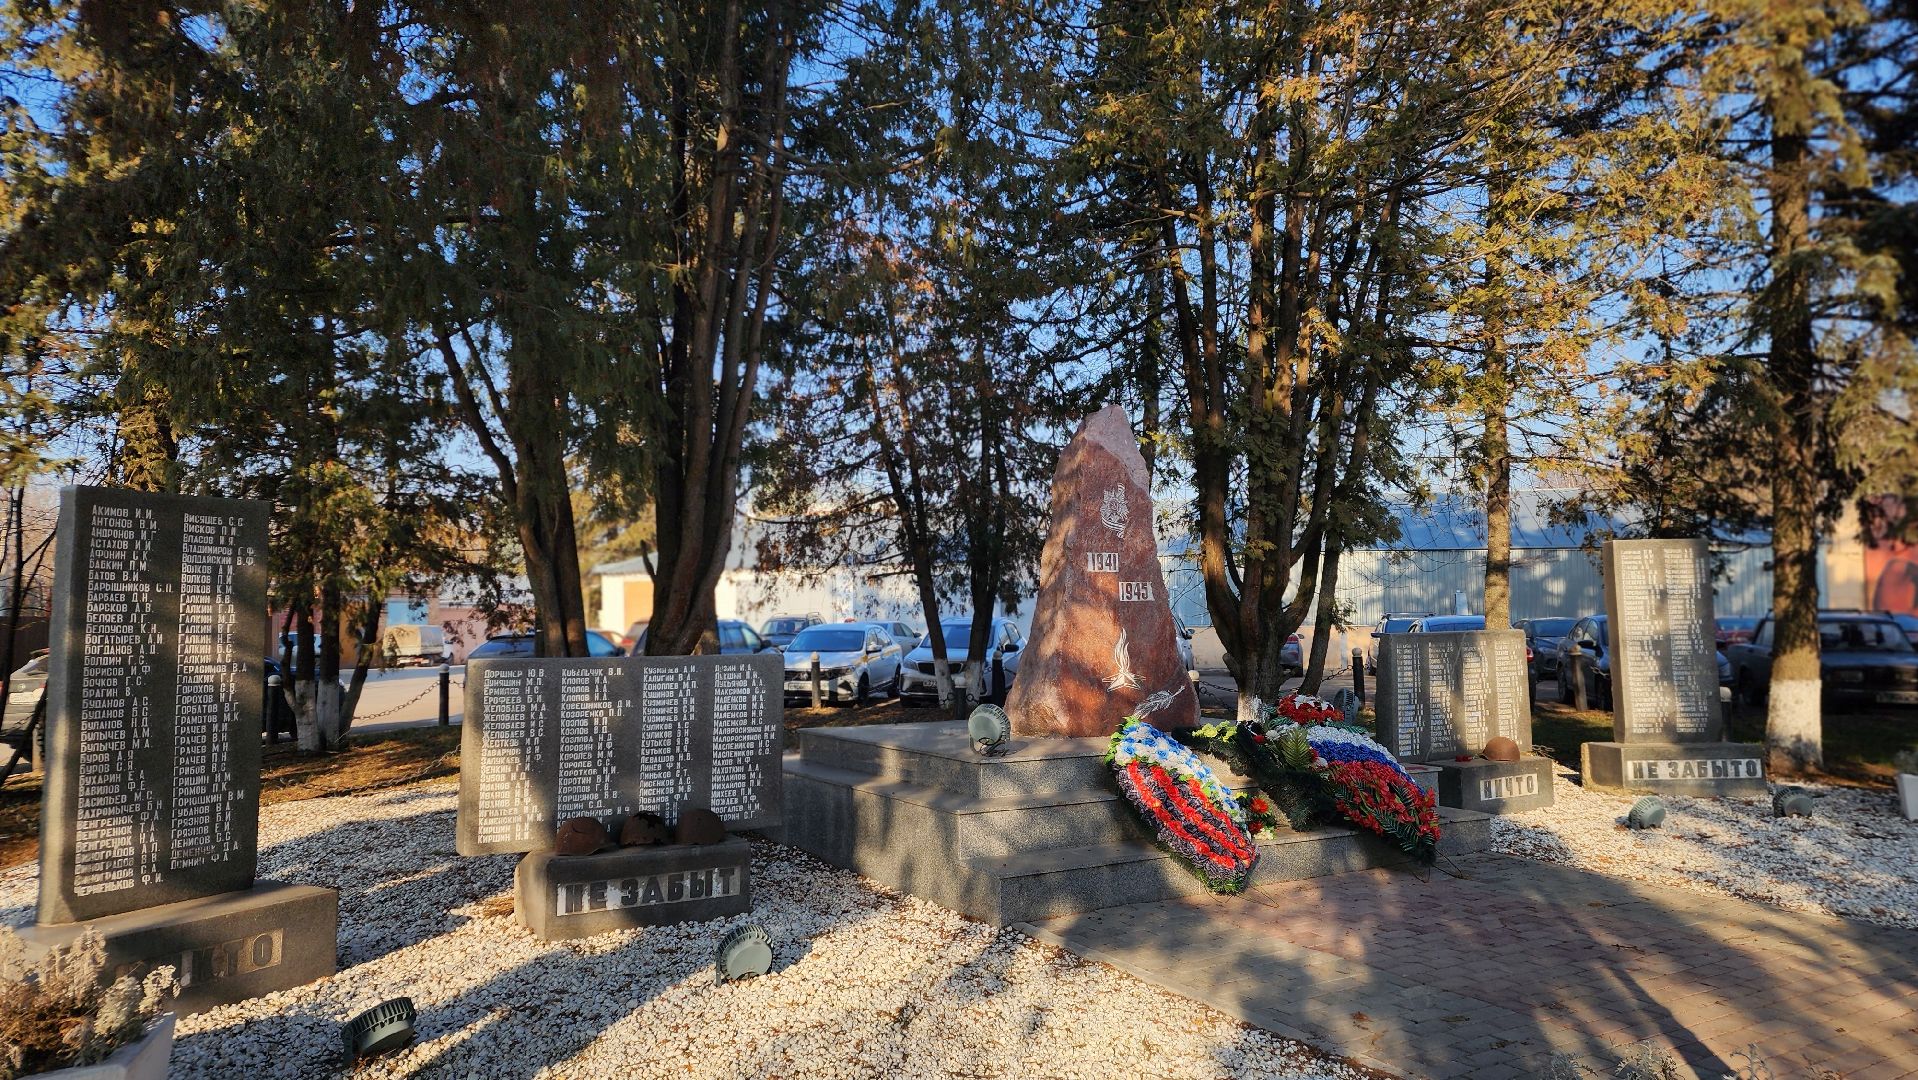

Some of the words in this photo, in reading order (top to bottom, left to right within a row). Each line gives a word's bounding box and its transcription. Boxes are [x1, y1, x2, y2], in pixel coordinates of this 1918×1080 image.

[92, 505, 129, 517] АКИМОВ
[91, 516, 132, 528] АНТОНОВ
[91, 527, 134, 539] АНДРОНОВ
[184, 523, 215, 534] ВИСКОВ
[91, 538, 128, 550] АСТАХОВ
[183, 534, 213, 544] ВЛАСОВ
[90, 548, 125, 560] АФОНИН
[182, 543, 232, 555] ВЛАДИМИРОВ
[89, 559, 122, 570] БАБКИН
[1091, 553, 1117, 571] 1941
[182, 563, 211, 574] ВОЛКОВ
[88, 570, 115, 580] БАТОВ
[122, 572, 142, 582] В.И.
[181, 574, 211, 583] ВОЛКОВ
[88, 580, 150, 592] БАРЫШНИКОВ
[181, 584, 210, 594] ВОЛКОВ
[88, 591, 125, 602] БАРБАЕВ
[1120, 582, 1149, 601] 1945
[180, 594, 210, 603] ГАЛКИН
[87, 602, 128, 612] БАРСКОВ
[180, 603, 212, 613] ГАЛКИН
[87, 613, 123, 623] БЕЛЯЕВ
[179, 613, 212, 624] ГАЛКИН
[86, 623, 133, 633] БЕЛОУСОВ
[179, 624, 212, 633] ГАЛКИН
[85, 634, 140, 644] БОГАТЫРЕВ
[178, 634, 211, 644] ГАЛКИН
[85, 645, 132, 655] БОГДАНОВ
[178, 645, 211, 654] ГАЛКИН
[84, 655, 121, 666] БОЛДИН
[178, 654, 211, 664] ГАЛКИН
[83, 666, 124, 676] БОРИСОВ
[177, 664, 226, 674] ГЕРАСИМОВ
[83, 676, 117, 687] БОЧКОВ
[177, 674, 214, 684] ГЛАДКИХ
[82, 688, 117, 698] БРАГИН
[176, 684, 213, 694] ГОРОХОВ
[484, 687, 519, 695] ЕРМИЛОВ
[82, 699, 124, 709] БУДАНОВ
[176, 695, 213, 705] ГОРОХОВ
[484, 696, 521, 704] ЕРОФЕЕВ
[175, 704, 218, 715] ГОРБАТОВ
[484, 704, 525, 712] ЖЕЛОБАЕВ
[82, 709, 124, 720] БУДАНОВ
[484, 713, 525, 721] ЖЕЛОБАЕВ
[175, 715, 217, 725] ГРАМОТОВ
[561, 719, 588, 727] КОЗЛОВ
[175, 725, 206, 735] ГРАЧЕВ
[483, 722, 525, 730] ЖЕЛОБАЕВ
[81, 730, 125, 742] БУЛЫЧЕВ
[483, 730, 524, 738] ЖЕЛОБАЕВ
[642, 732, 672, 740] КУЛИКОВ
[174, 735, 206, 745] ГРАЧЕВ
[560, 736, 593, 744] КОЗЛОВА
[81, 740, 125, 752] БУЛЫЧЕВ
[174, 746, 206, 756] ГРАЧЕВ
[560, 744, 592, 752] КОРОВИН
[80, 752, 109, 763] БУРОВ
[174, 756, 206, 766] ГРАЧЕВ
[560, 752, 592, 761] КОРОЛЕВ
[80, 763, 109, 775] БУРОВ
[560, 761, 592, 769] КОРОЛЕВ
[1632, 759, 1660, 779] НЕ
[1667, 759, 1759, 779] ЗАБЫТО
[173, 766, 205, 776] ГРИБОВ
[79, 773, 121, 787] БУХАРИН
[79, 785, 120, 797] ВАВИЛОВ
[173, 785, 206, 798] ГРОМОВ
[1482, 775, 1536, 800] НИЧТО
[78, 794, 127, 808] ВАСИЛЬЕВ
[172, 794, 222, 808] ГОРЮШКИН
[78, 803, 140, 820] ВАХРОМЫЧЕВ
[172, 805, 209, 818] ГУБАНОВ
[77, 815, 133, 831] ВЕНГРЕНЮК
[171, 815, 209, 828] ГРЯЗНОВ
[171, 825, 208, 839] ГРЯЗНОВ
[171, 836, 210, 849] ДЕНИСОВ
[565, 882, 607, 914] НЕ
[620, 868, 735, 905] ЗАБЫТ
